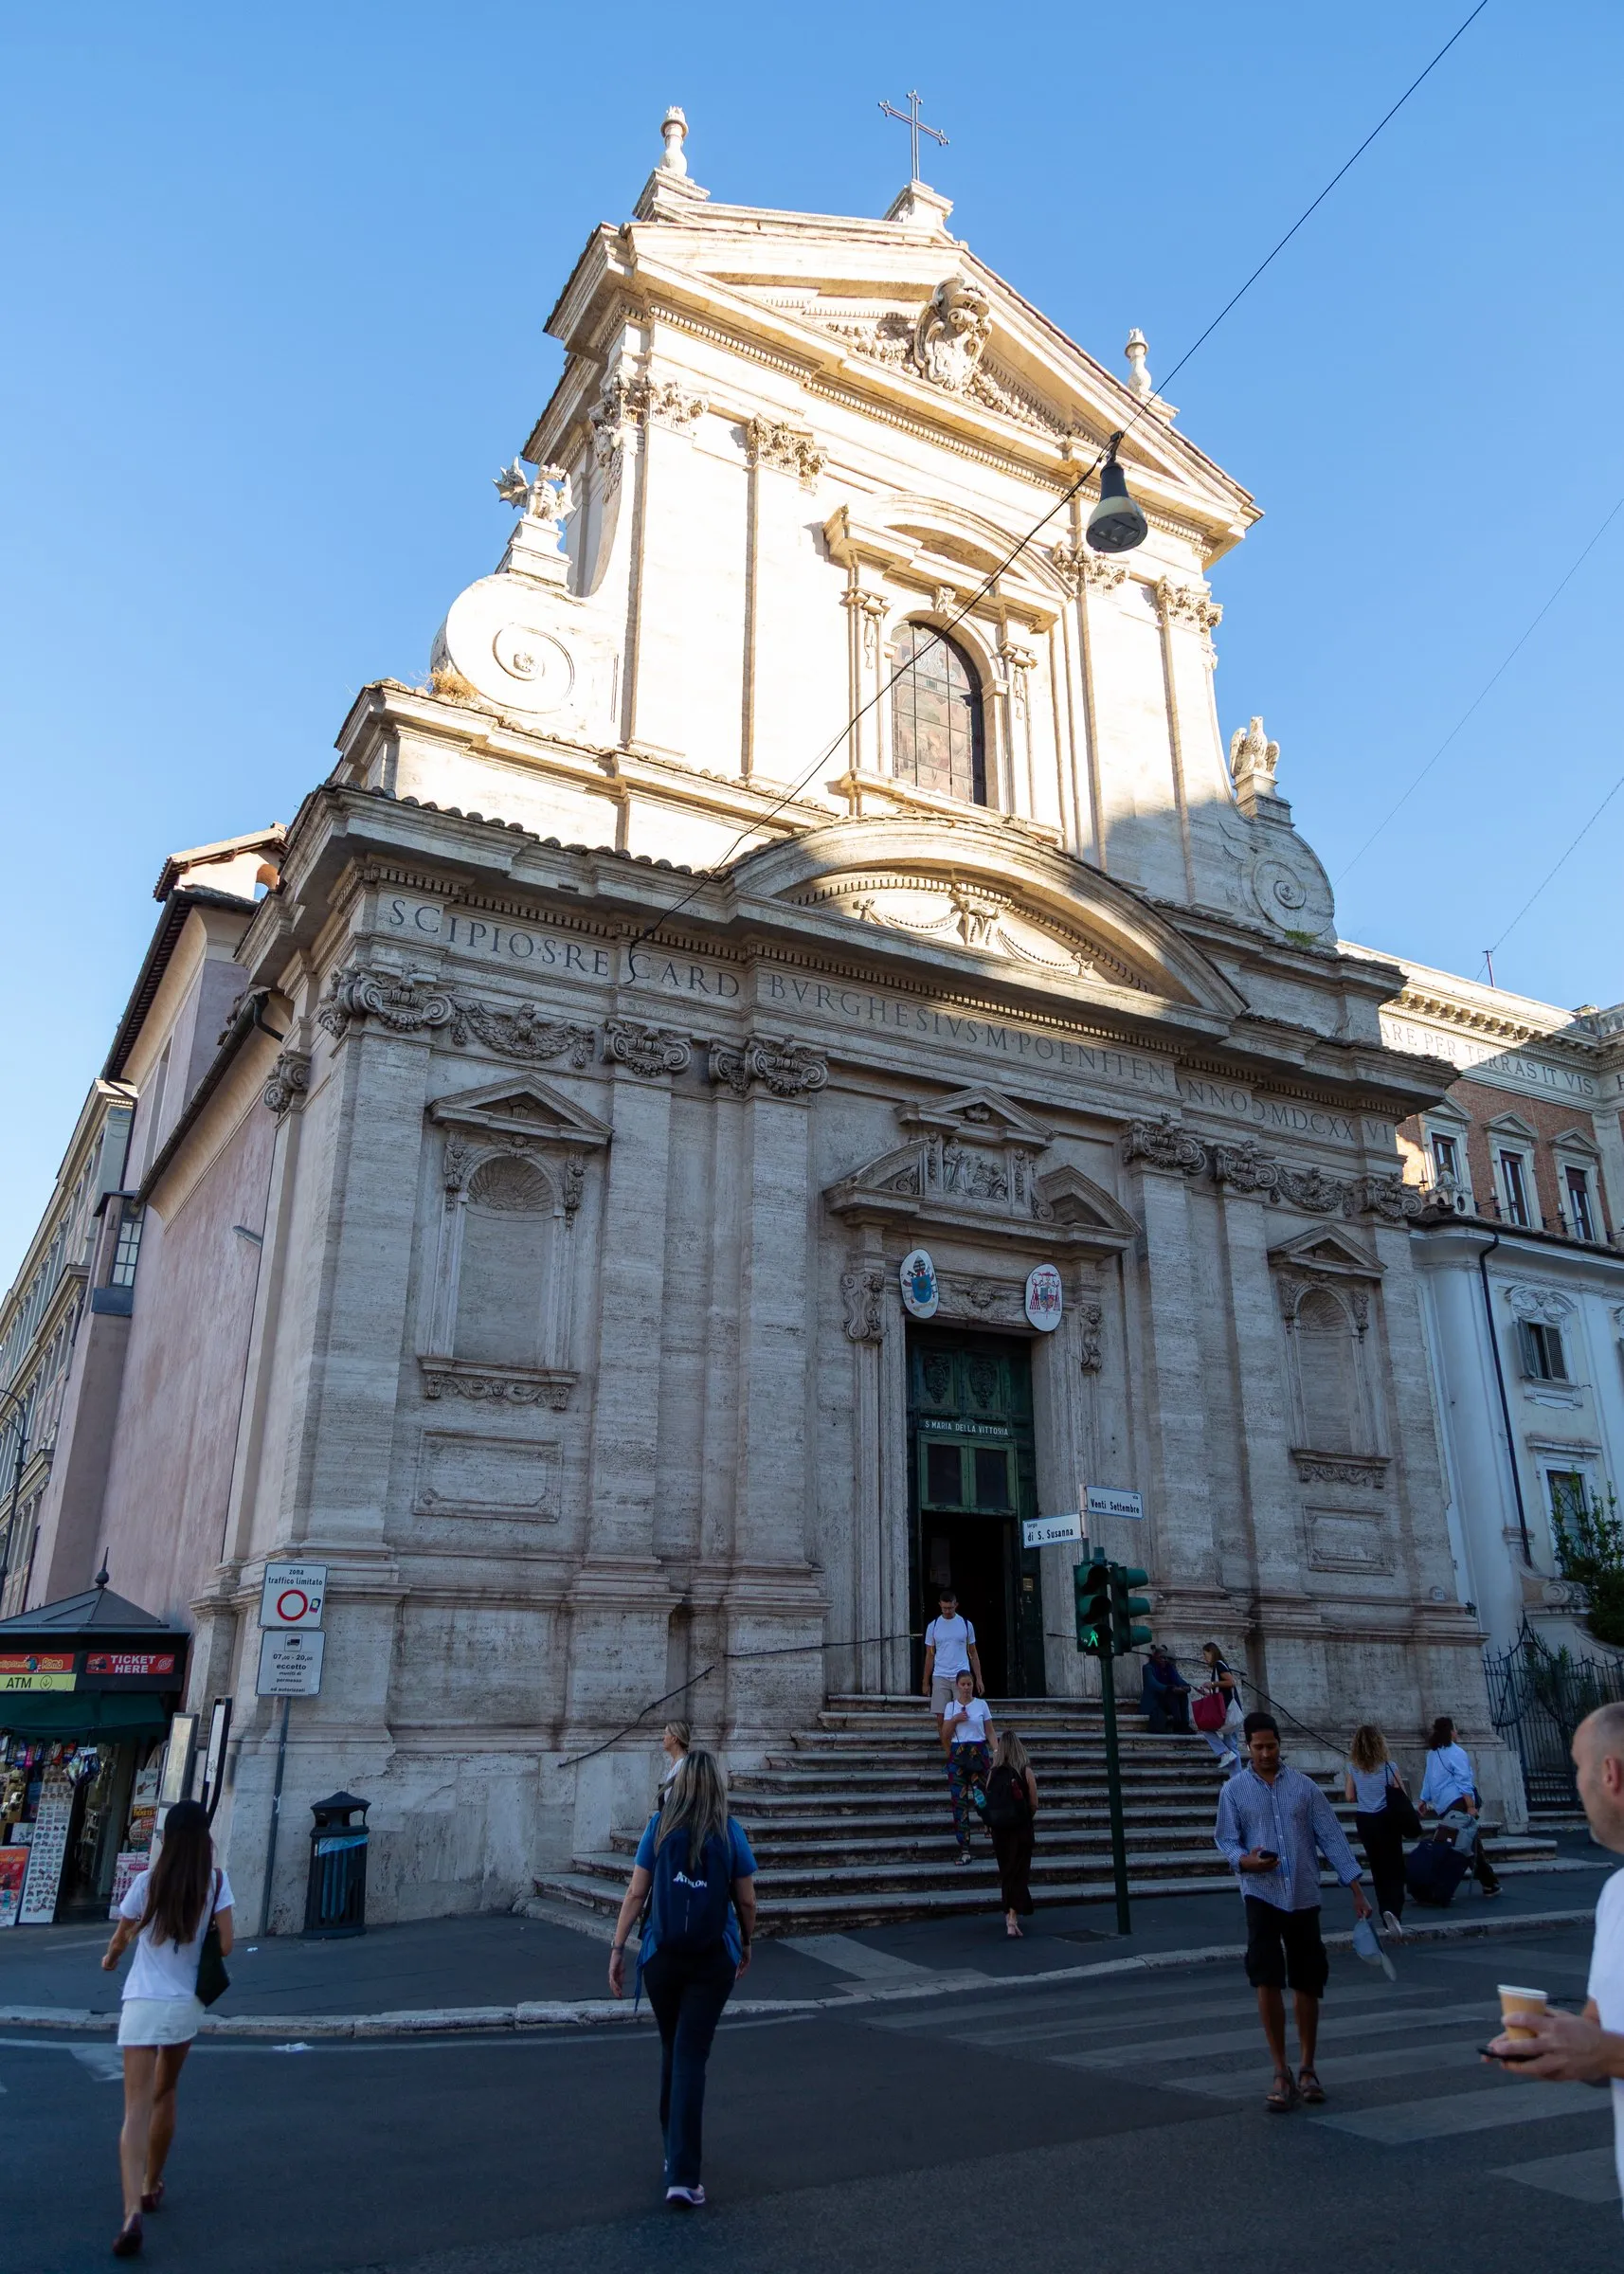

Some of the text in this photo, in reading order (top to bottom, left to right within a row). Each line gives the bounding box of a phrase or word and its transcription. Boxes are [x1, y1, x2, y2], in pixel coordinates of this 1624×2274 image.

[1424, 1033, 1457, 1056] PER
[1465, 1045, 1537, 1079] TERRAS
[1563, 1074, 1594, 1095] VIS
[931, 1421, 951, 1430] MARIA
[955, 1423, 976, 1433] DELLA
[979, 1426, 1008, 1435] VITTORIA
[1091, 1498, 1140, 1514] Venti Settembre
[1028, 1527, 1074, 1542] di S. Susanna
[268, 1577, 323, 1586] traffico limitato
[42, 1657, 63, 1669] Roma
[110, 1655, 156, 1664] TICKET
[115, 1665, 149, 1673] HERE
[6, 1677, 32, 1688] ATM
